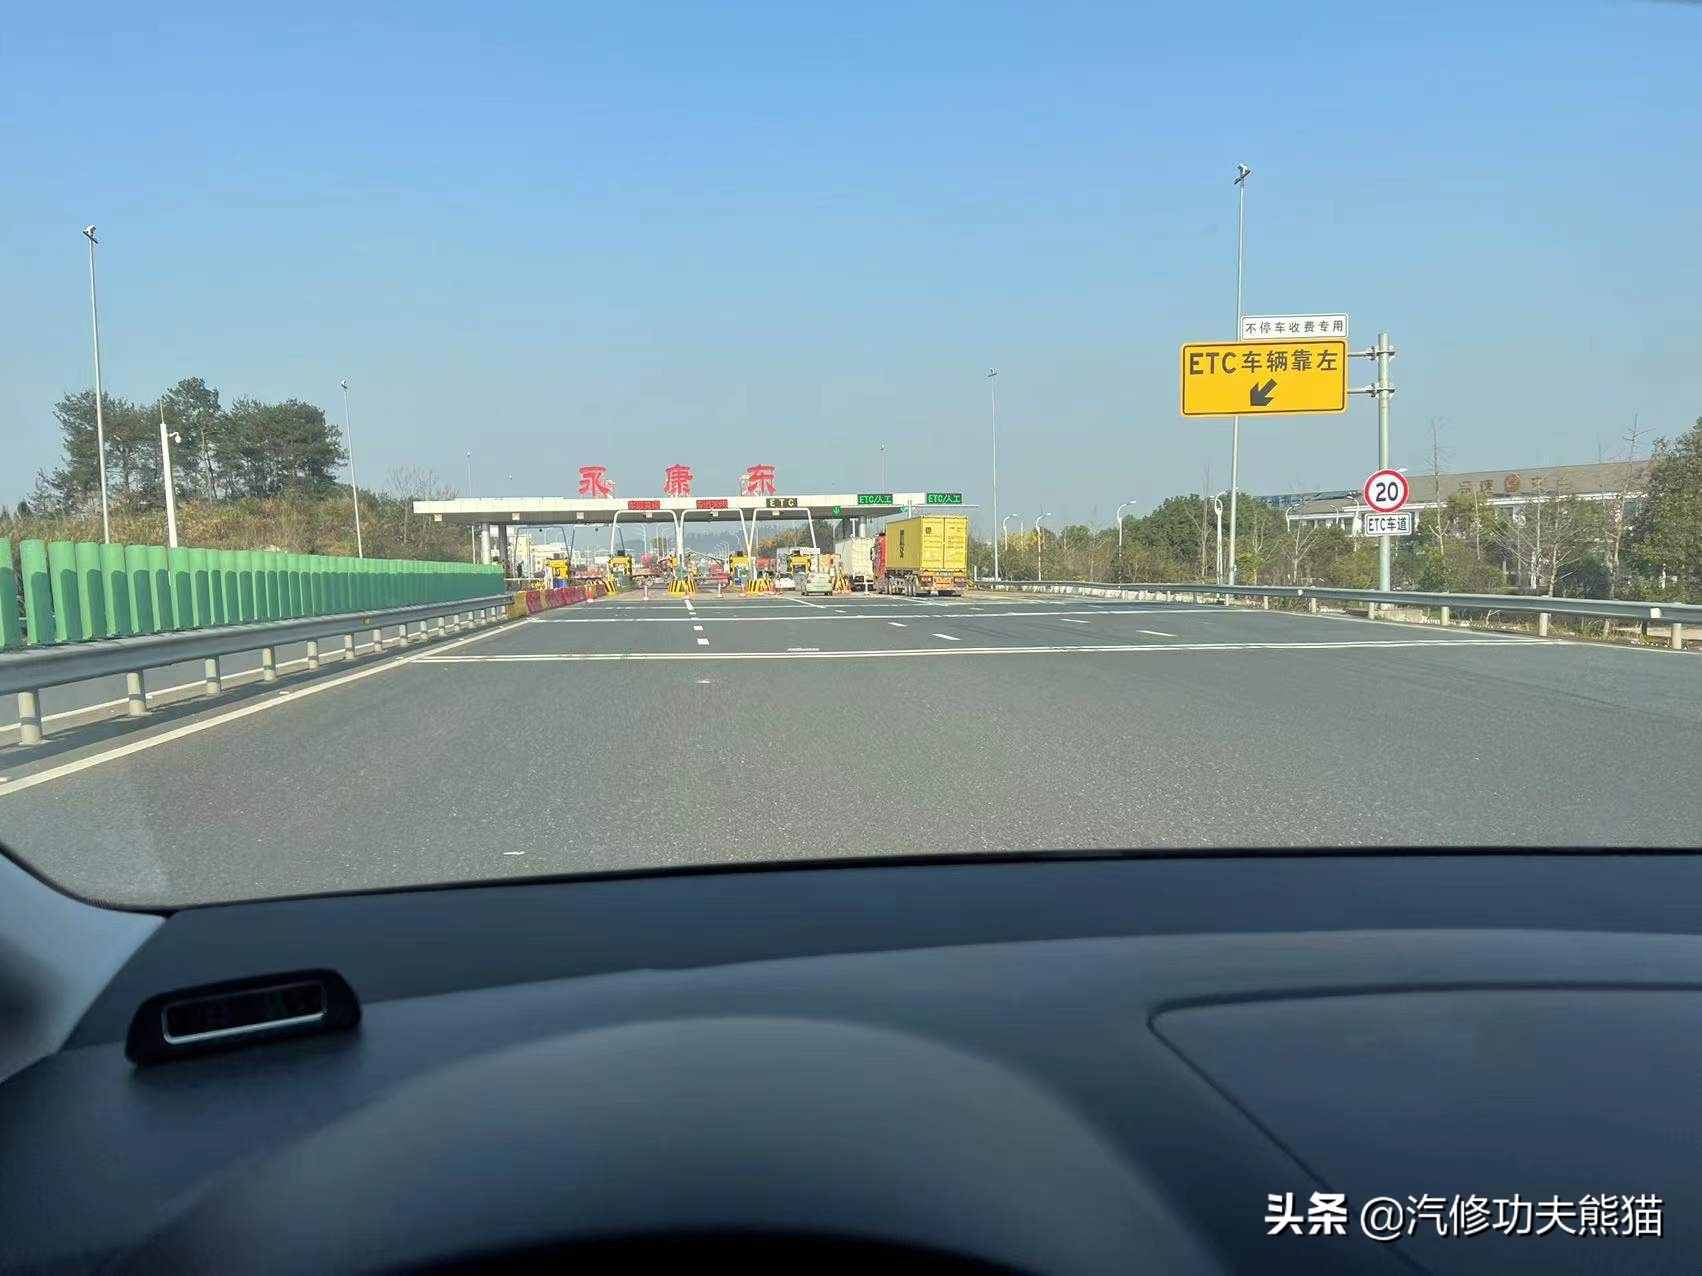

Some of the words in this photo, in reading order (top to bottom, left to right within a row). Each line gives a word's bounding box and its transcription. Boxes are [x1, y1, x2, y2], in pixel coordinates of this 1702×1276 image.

[1245, 320, 1344, 335] 不停车收费专用
[1189, 349, 1339, 375] ETC车辆靠左
[579, 464, 777, 498] 永康东
[1375, 481, 1399, 502] 20
[768, 499, 795, 508] ETC
[1368, 517, 1408, 532] ETC车道
